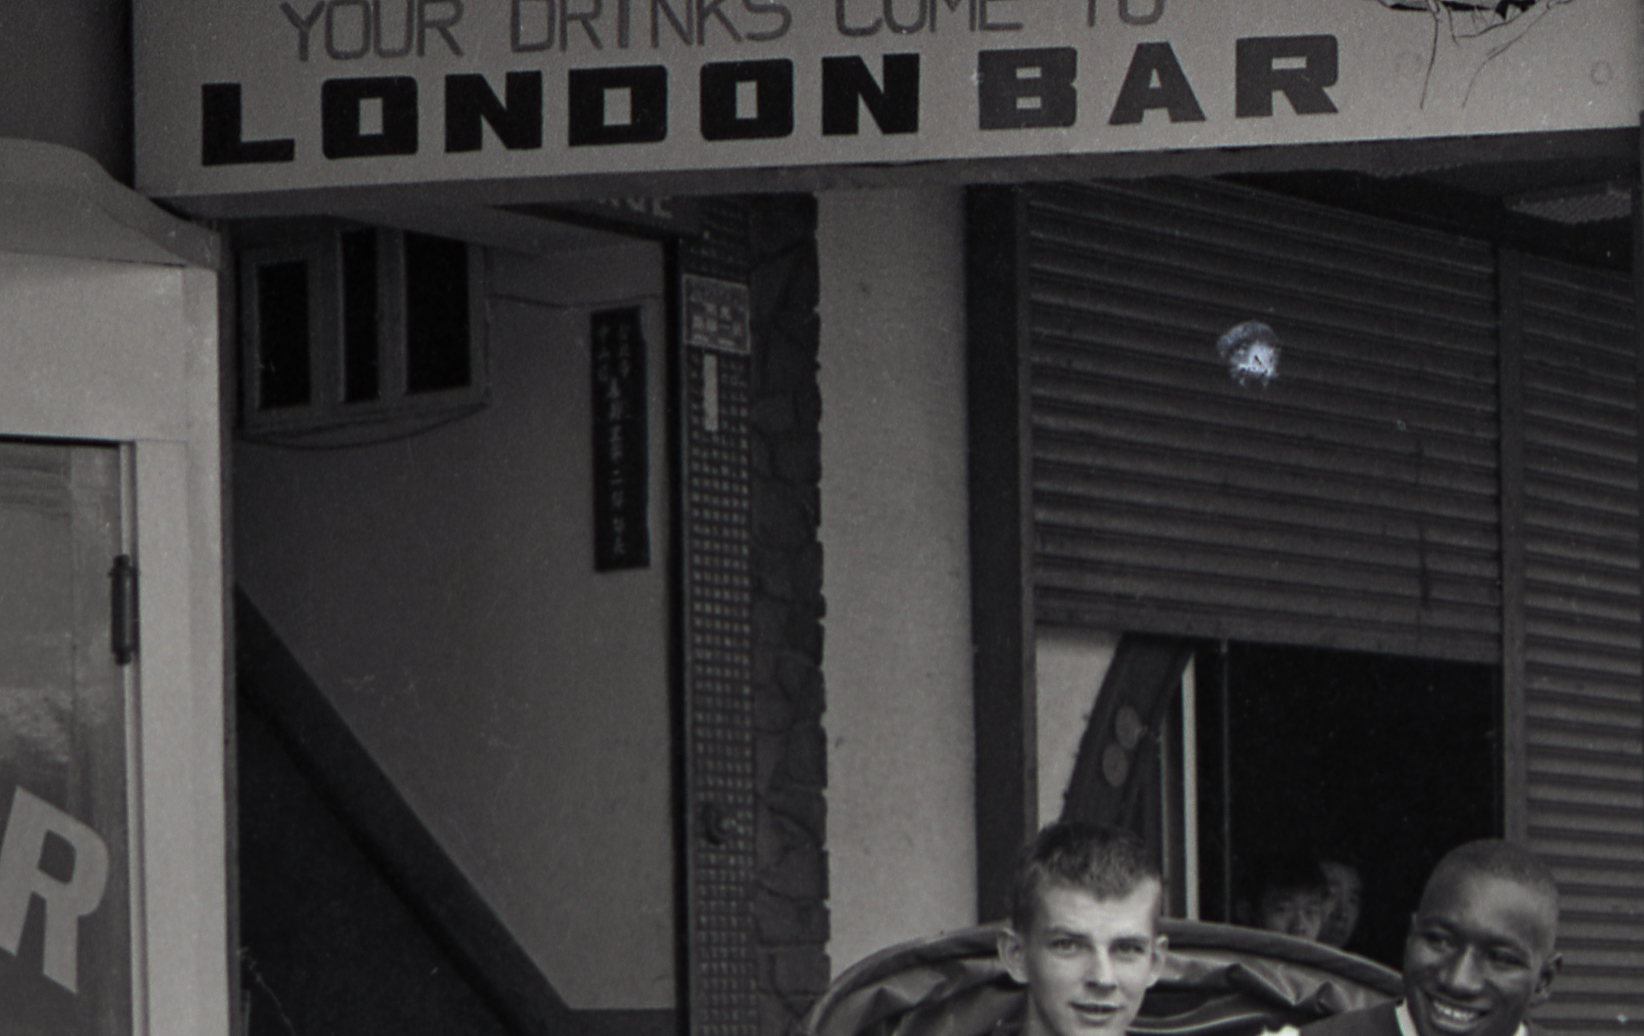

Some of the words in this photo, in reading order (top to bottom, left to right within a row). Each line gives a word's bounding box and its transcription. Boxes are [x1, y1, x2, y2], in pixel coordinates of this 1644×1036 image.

[281, 0, 464, 62] YOUR
[510, 0, 793, 54] DRINKS
[200, 52, 920, 167] LONDON
[978, 34, 1339, 131] BAR
[0, 785, 110, 994] R
